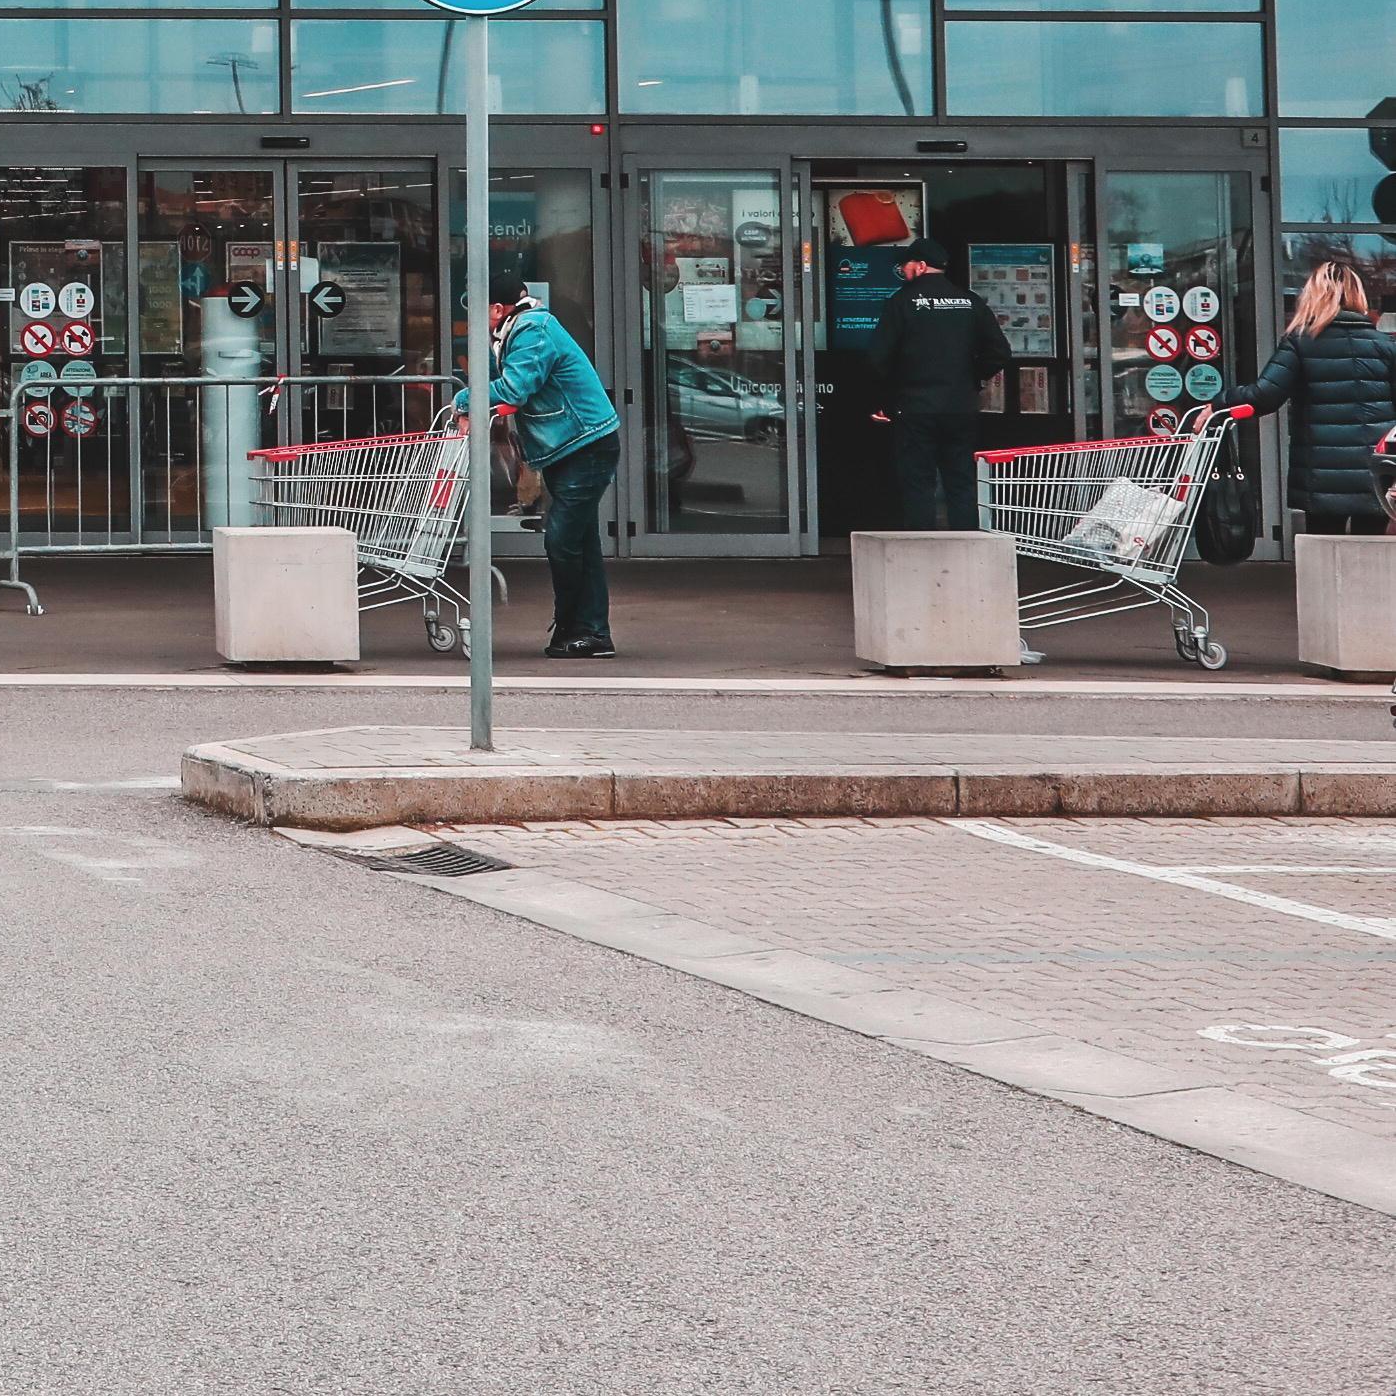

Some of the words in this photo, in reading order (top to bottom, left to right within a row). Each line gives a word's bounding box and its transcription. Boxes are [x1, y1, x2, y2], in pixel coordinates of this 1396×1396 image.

[1251, 133, 1259, 144] 4
[747, 209, 776, 218] valori
[934, 297, 972, 306] RANGERS
